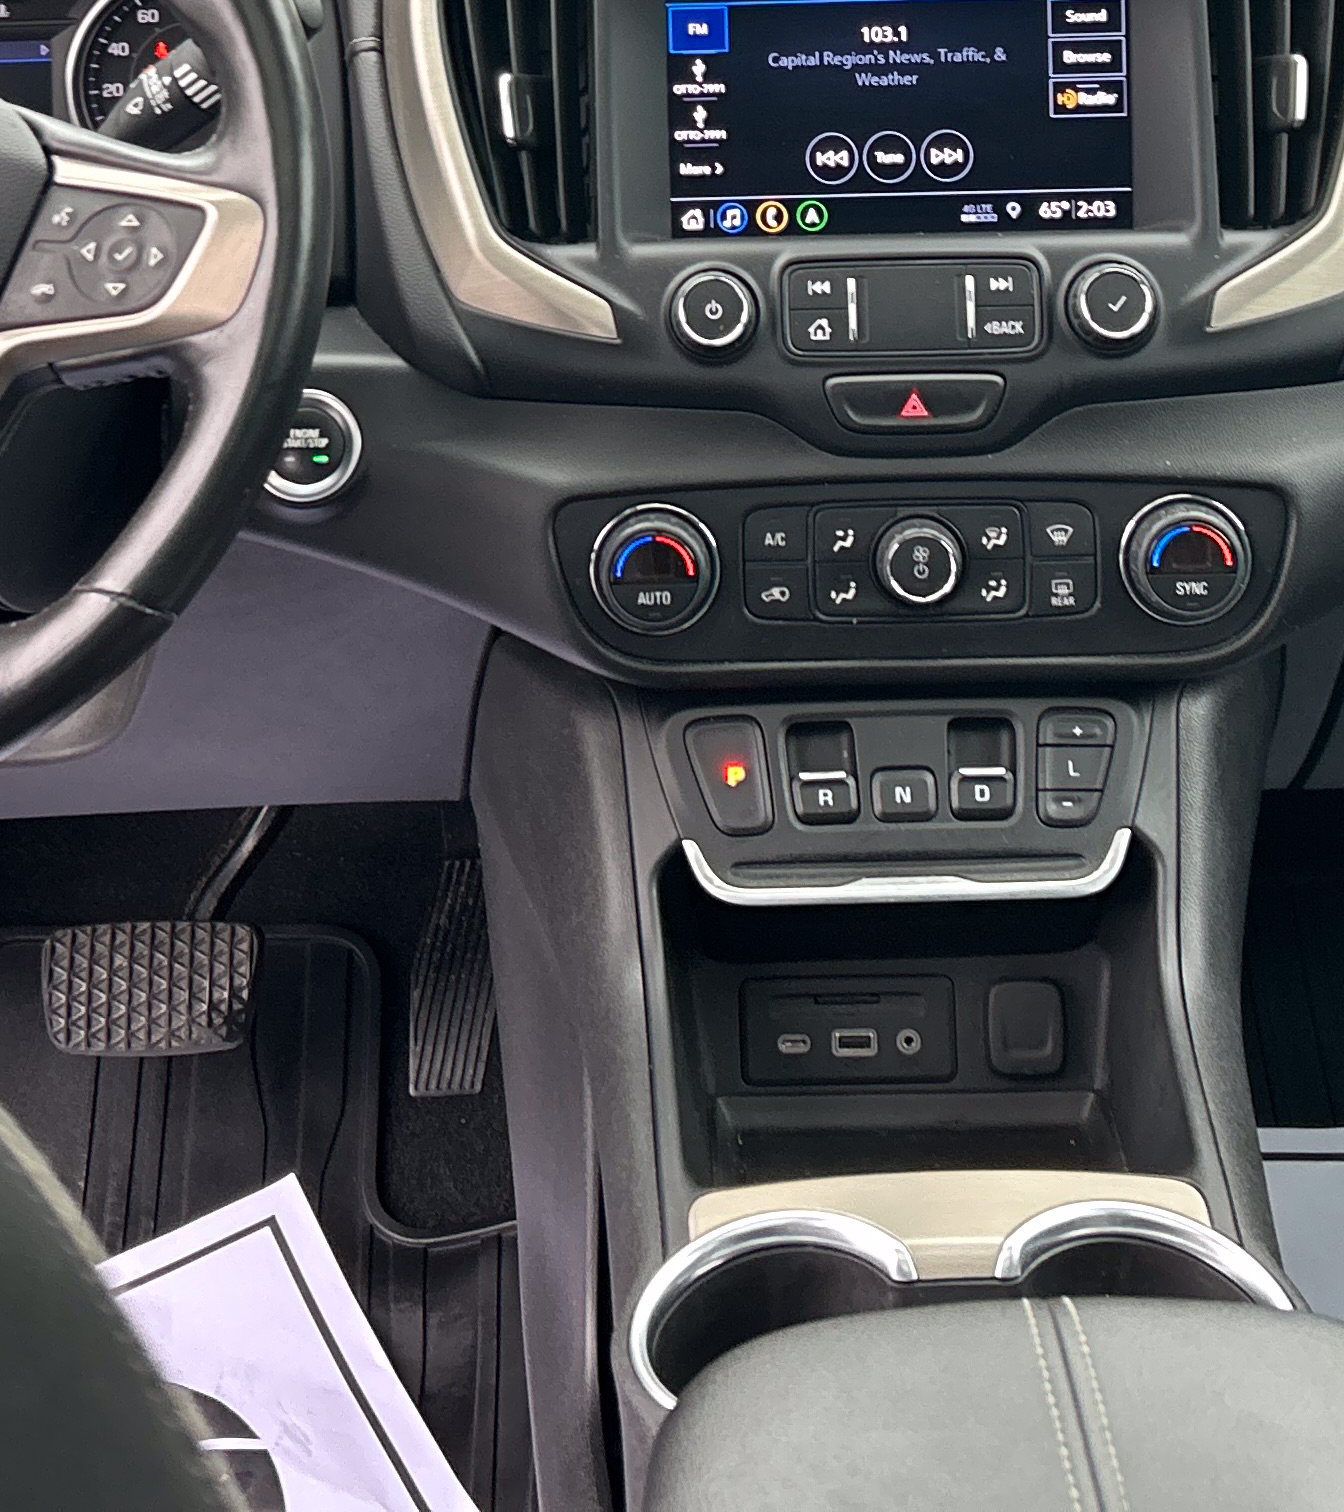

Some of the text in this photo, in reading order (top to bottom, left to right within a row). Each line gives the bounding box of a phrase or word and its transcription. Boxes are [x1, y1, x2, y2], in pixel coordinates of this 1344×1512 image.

[136, 9, 160, 24] 60
[1065, 8, 1108, 23] Sound
[687, 23, 709, 36] FM
[860, 25, 908, 43] 103.1
[107, 41, 130, 57] 40
[1062, 49, 1113, 64] Browse
[767, 46, 1008, 71] Capital Region's News, Traffic, &
[854, 70, 919, 87] Weather
[102, 82, 124, 97] 20
[874, 150, 905, 165] Tune
[1076, 199, 1117, 219] 2:03
[991, 319, 1025, 335] BACK
[763, 531, 786, 547] A/C
[1175, 580, 1209, 597] SYNC
[636, 590, 672, 606] AUTO
[1050, 595, 1076, 607] REAR
[1067, 759, 1081, 778] L
[818, 789, 834, 807] R
[894, 786, 912, 804] N
[973, 784, 991, 803] D
